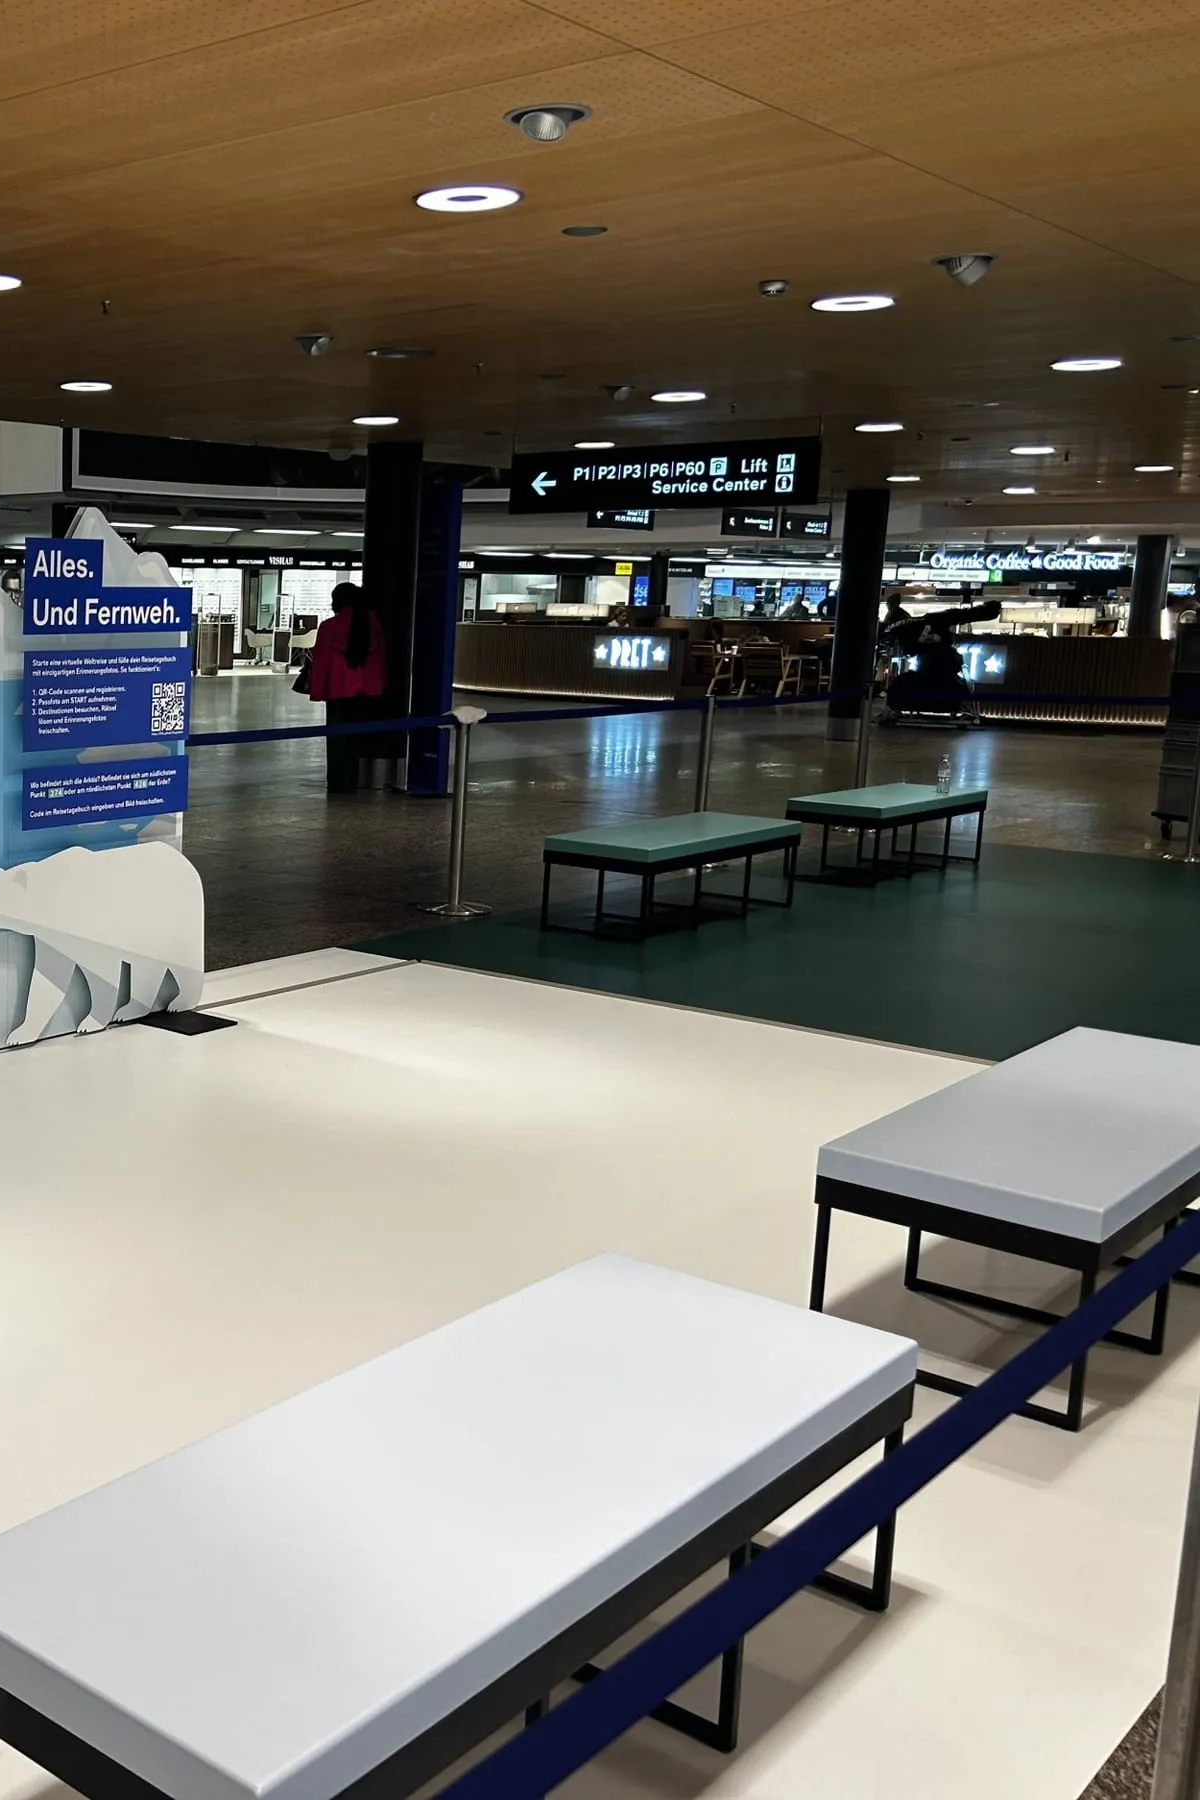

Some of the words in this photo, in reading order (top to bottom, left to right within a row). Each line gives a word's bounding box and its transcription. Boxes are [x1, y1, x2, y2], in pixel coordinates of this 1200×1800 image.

[740, 458, 768, 473] Lift
[652, 480, 708, 494] Service
[712, 478, 767, 492] Center
[32, 550, 94, 578] Alles.
[930, 552, 984, 570] Organic
[986, 552, 1028, 570] Coffee
[1044, 554, 1082, 570] Good
[1084, 554, 1120, 570] Food
[32, 598, 78, 626] Und
[84, 596, 180, 626] Fernweh.
[142, 656, 176, 664] Reisetagebuch
[610, 638, 652, 668] PRET
[42, 668, 75, 677] einzigartigen
[101, 774, 121, 782] Befindet
[53, 806, 90, 815] Reisetagebuch
